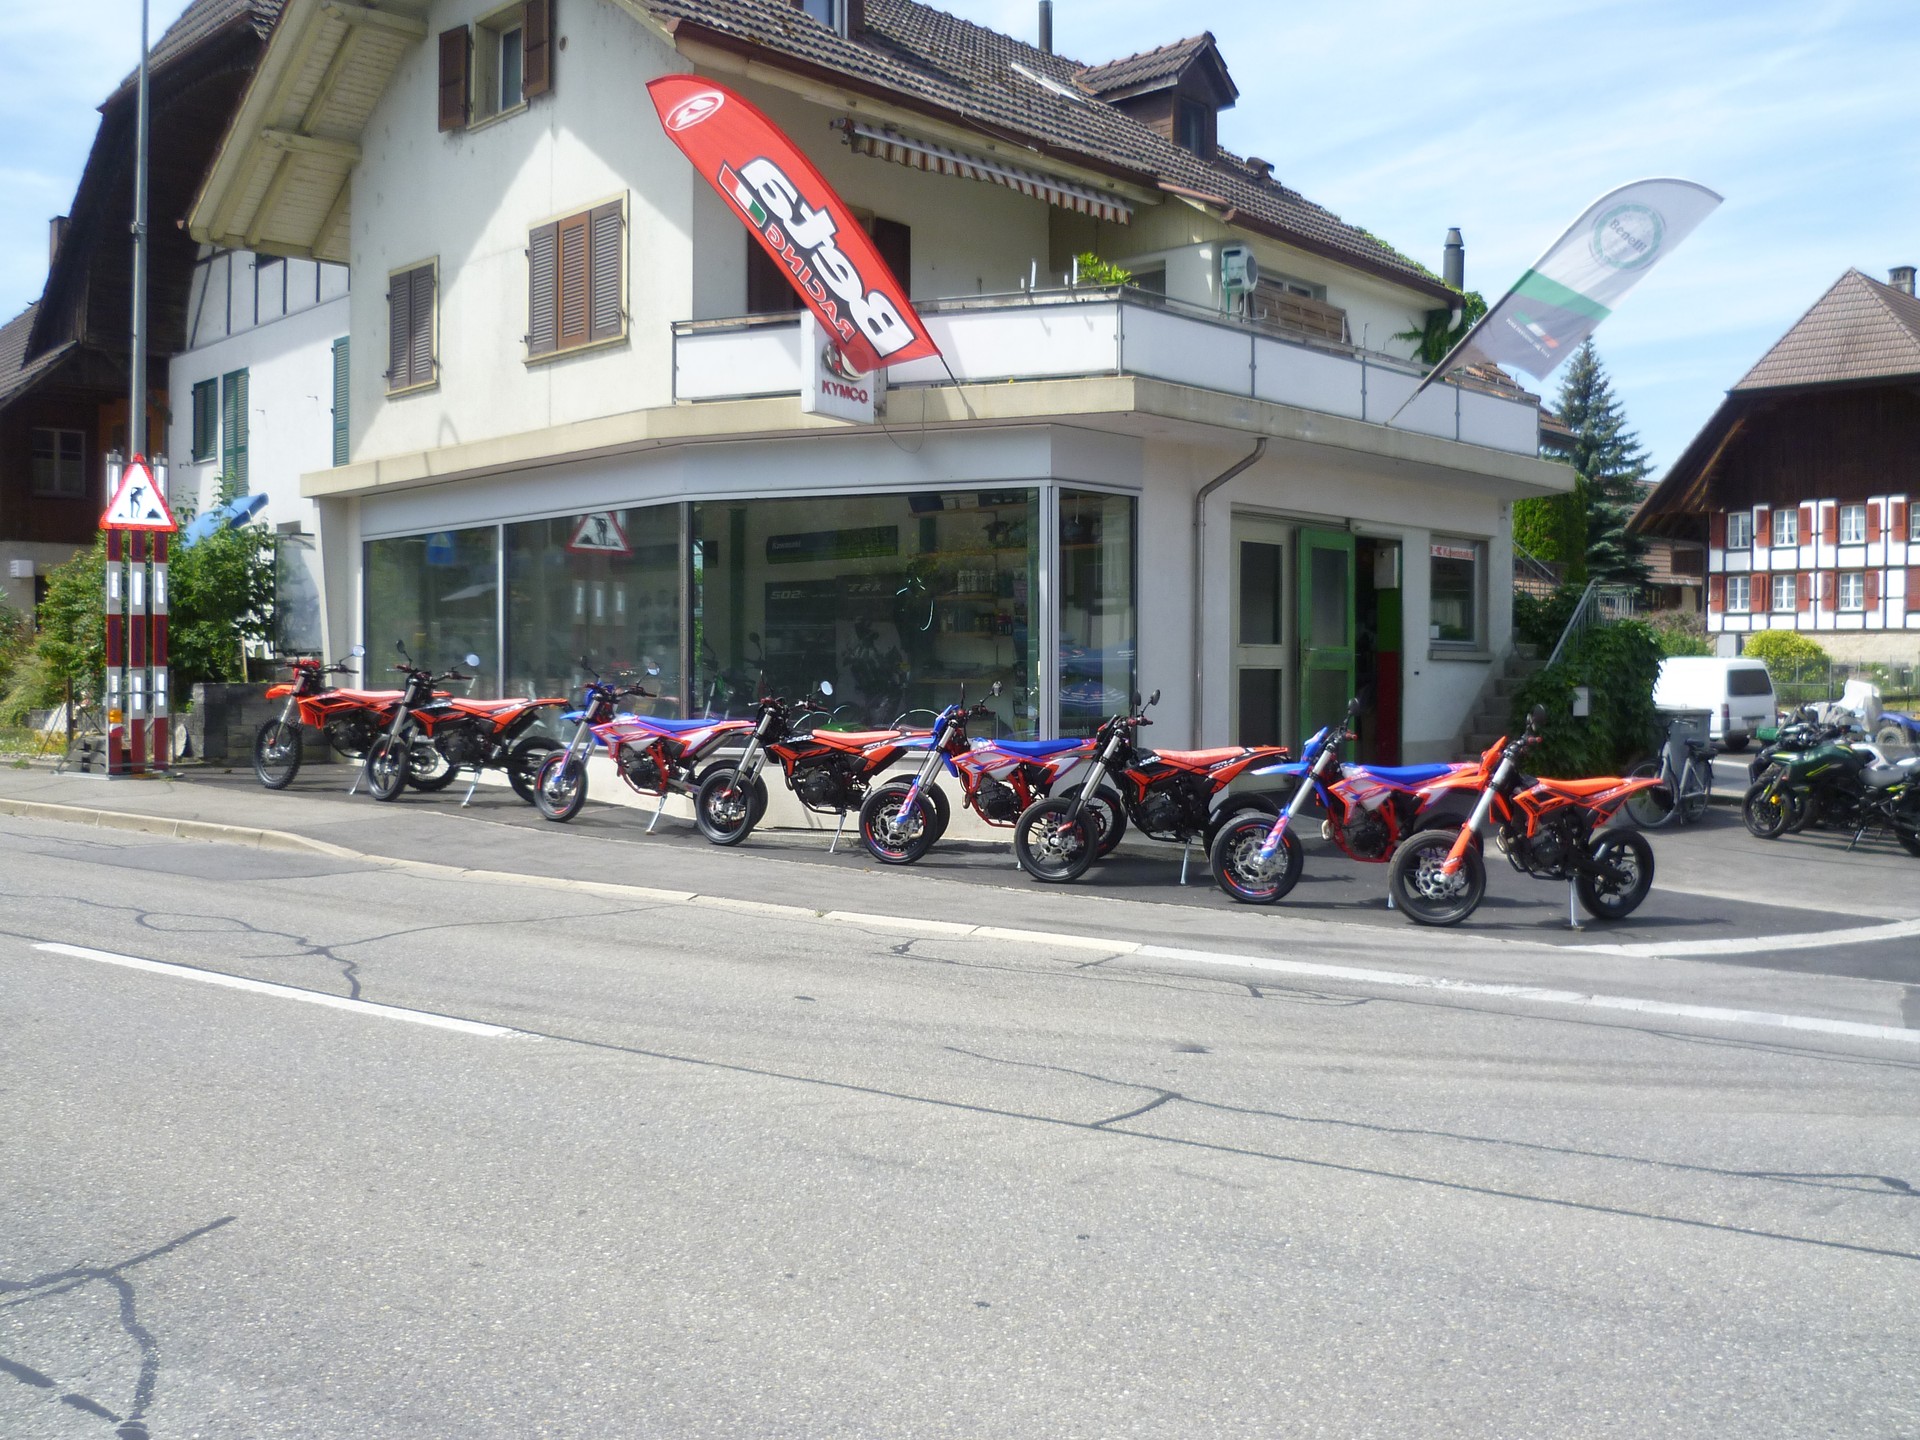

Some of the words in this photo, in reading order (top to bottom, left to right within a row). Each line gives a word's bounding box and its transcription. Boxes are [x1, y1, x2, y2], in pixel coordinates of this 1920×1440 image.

[1609, 217, 1648, 253] Benelli
[821, 379, 868, 404] KYMCO
[1059, 726, 1090, 737] awasaki
